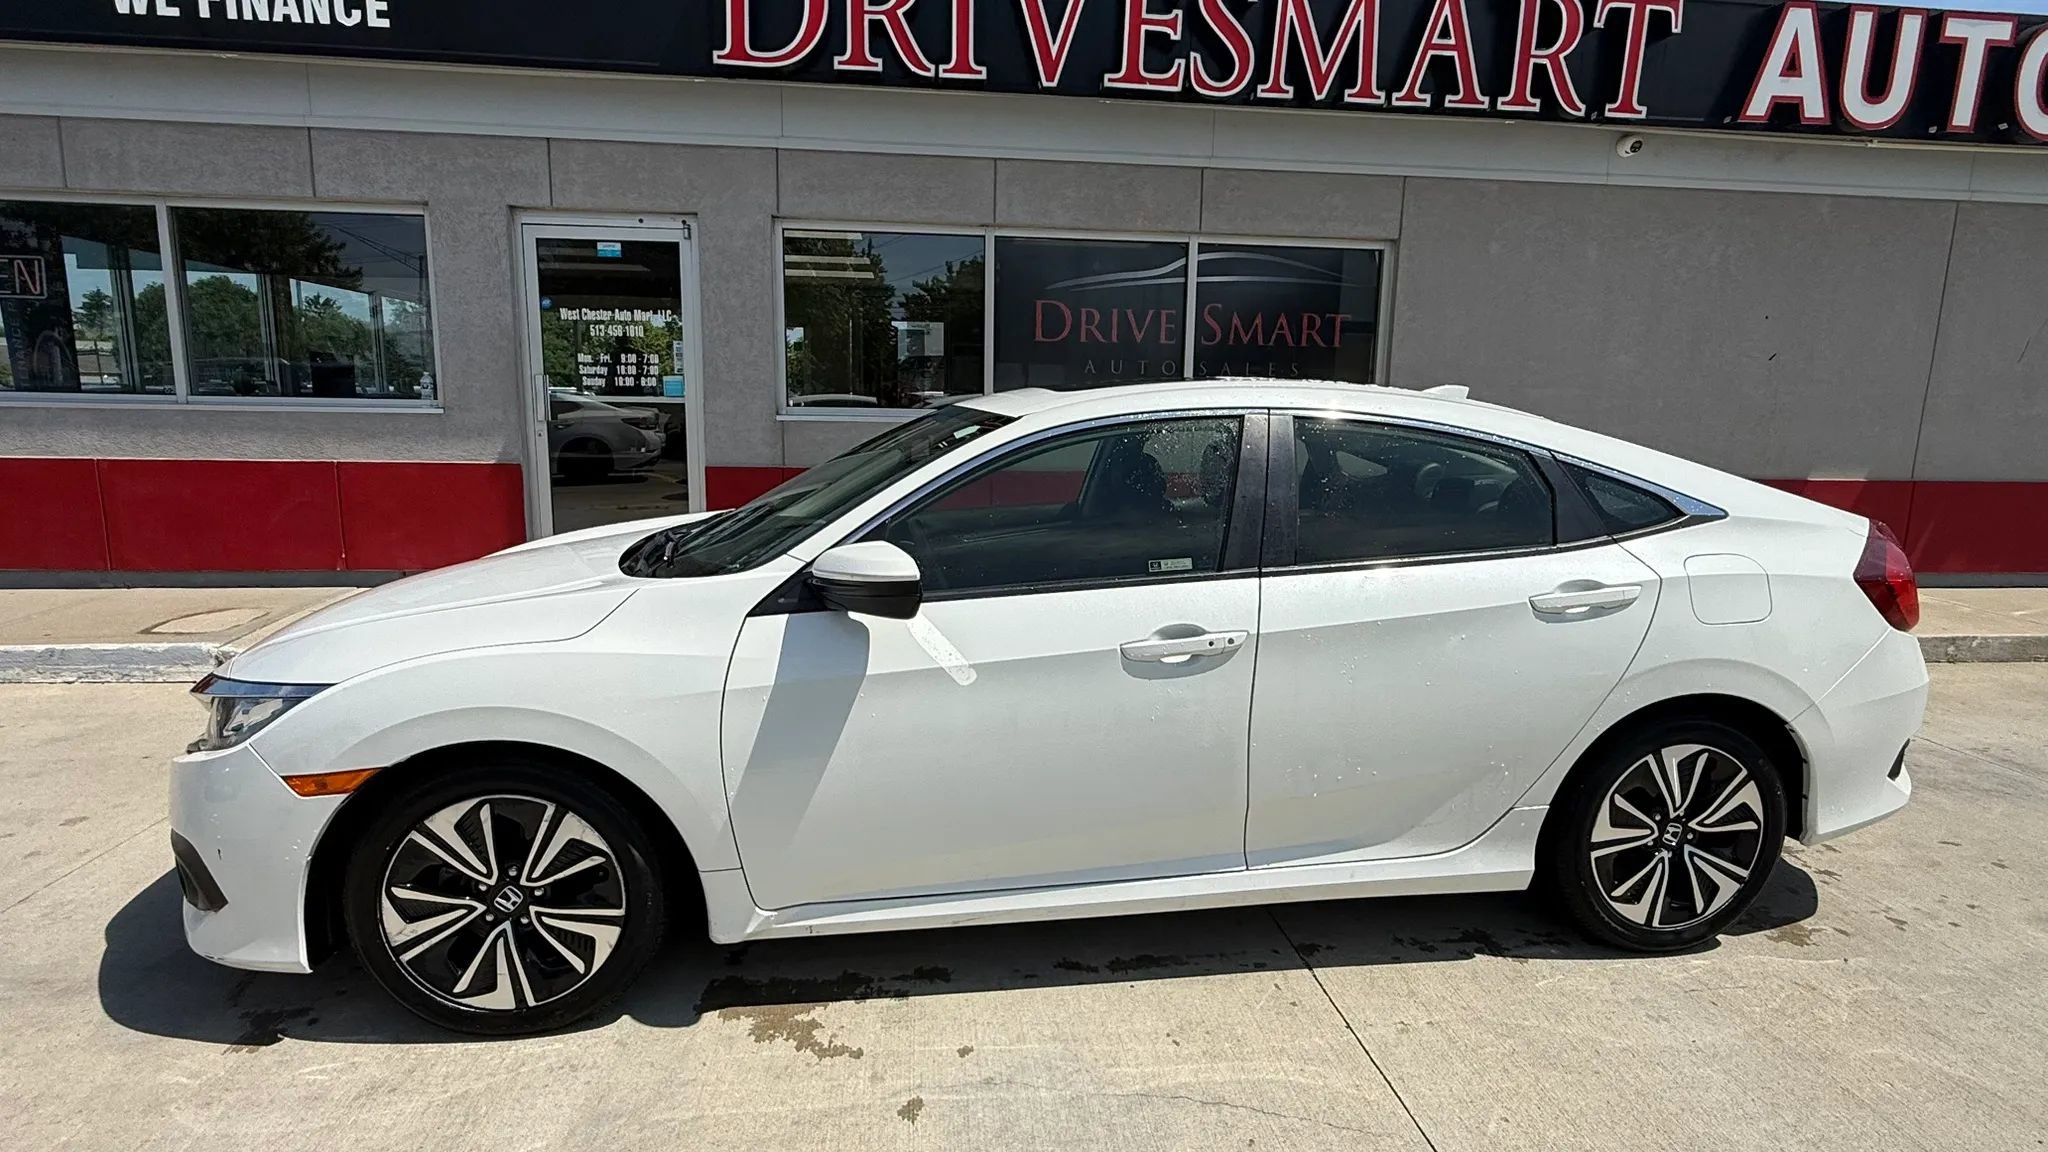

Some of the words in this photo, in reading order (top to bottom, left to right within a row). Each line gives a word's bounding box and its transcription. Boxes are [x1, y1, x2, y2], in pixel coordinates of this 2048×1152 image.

[560, 307, 581, 321] West
[581, 307, 611, 321] Chester
[614, 308, 632, 321] Auto
[1033, 299, 1177, 345] DRIVE
[1200, 303, 1354, 349] SMART
[578, 365, 608, 376] Saturday
[1084, 359, 1177, 377] AUTO
[1199, 360, 1299, 377] SALES
[582, 376, 606, 387] Sunday
